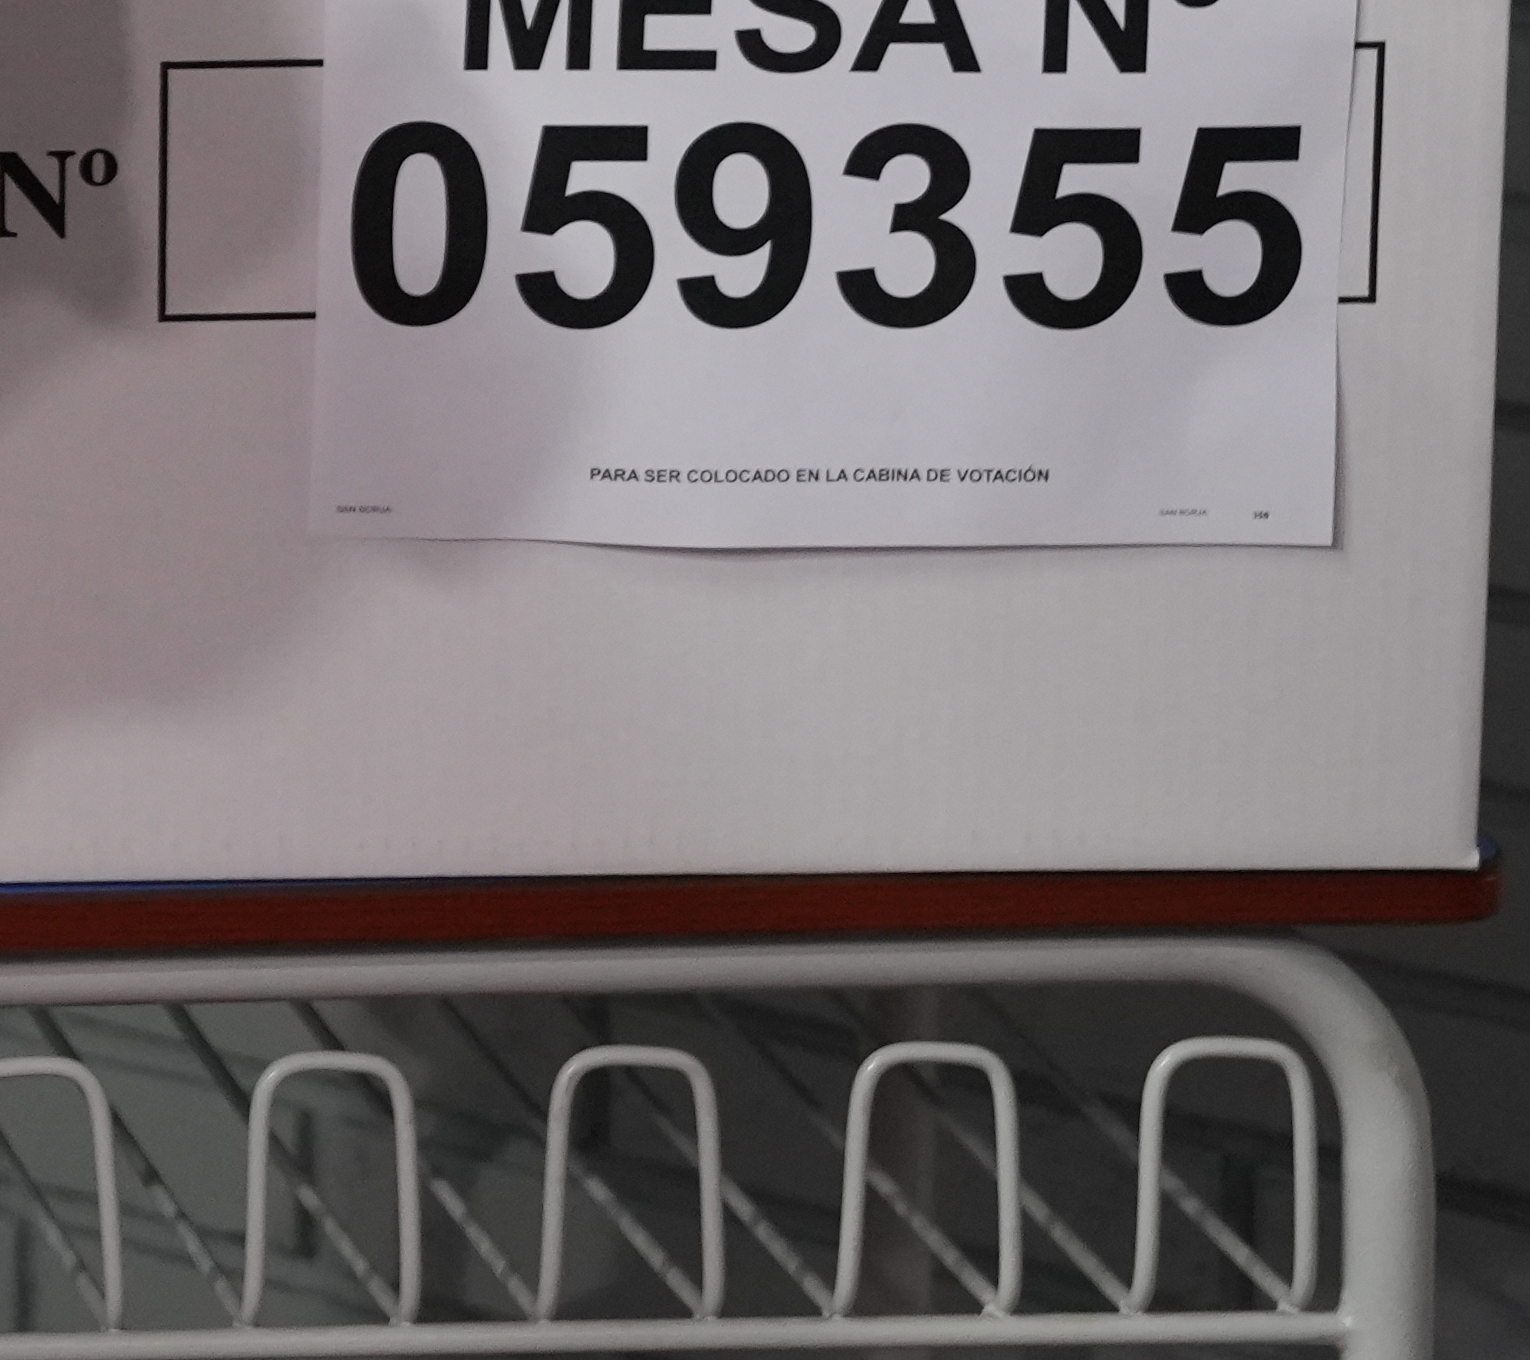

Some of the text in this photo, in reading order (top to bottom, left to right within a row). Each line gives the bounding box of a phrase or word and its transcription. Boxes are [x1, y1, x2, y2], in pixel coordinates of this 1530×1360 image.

[351, 121, 1303, 330] 059355
[589, 464, 1050, 484] PARA SER COLOCADO EN LA CABINA DE VOTACIÓN
